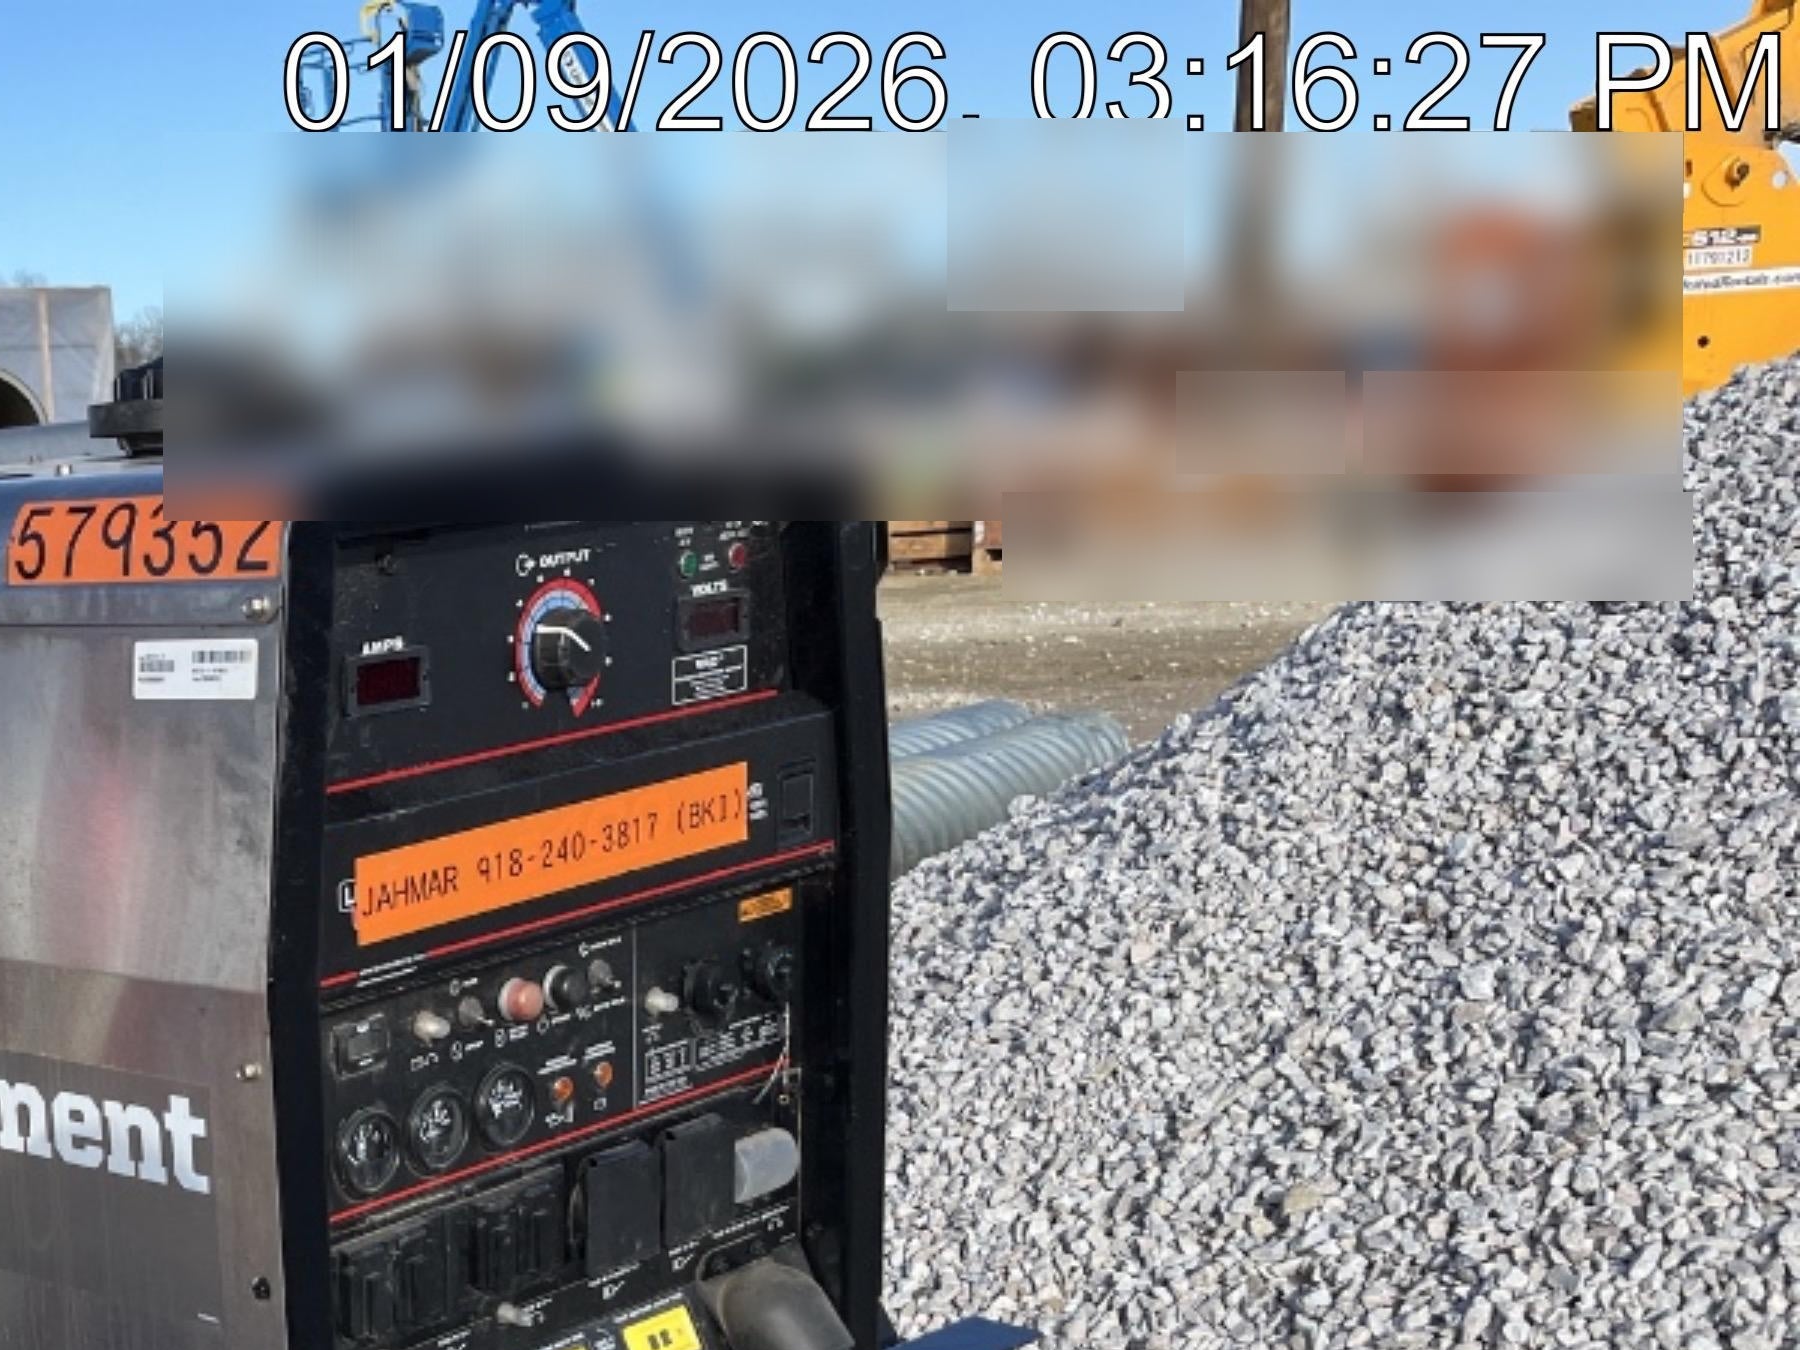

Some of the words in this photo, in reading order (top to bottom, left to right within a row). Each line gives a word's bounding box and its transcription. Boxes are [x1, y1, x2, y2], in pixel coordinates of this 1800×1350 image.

[14, 502, 271, 580] 579352
[539, 548, 591, 569] OUTPUT
[690, 579, 728, 598] VOLTS
[362, 635, 405, 657] AMPS
[361, 866, 459, 918] JAHMAR
[478, 811, 659, 882] 918-240-3817
